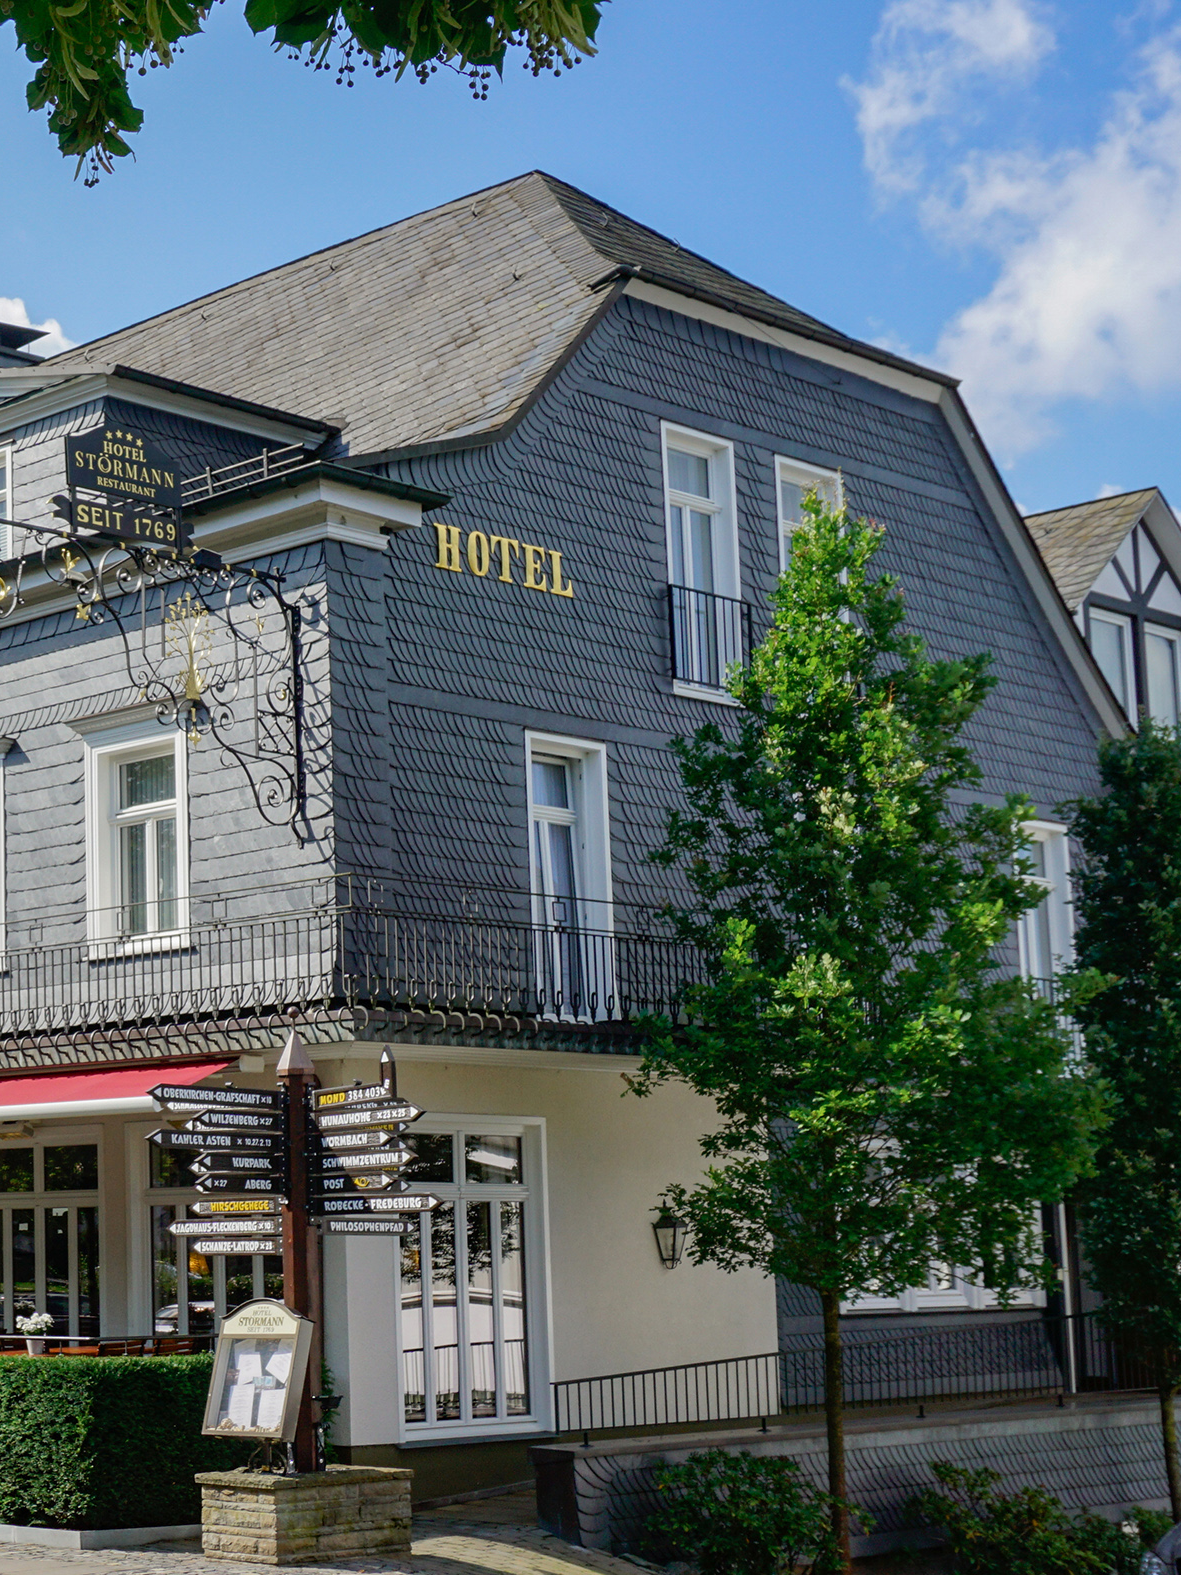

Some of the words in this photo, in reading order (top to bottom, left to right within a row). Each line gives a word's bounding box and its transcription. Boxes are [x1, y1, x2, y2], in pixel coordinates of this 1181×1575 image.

[103, 440, 147, 463] HOTEL
[75, 450, 174, 488] STÖRMANN
[97, 476, 156, 498] RESTAURANT
[77, 504, 123, 530] SEIT
[134, 517, 176, 541] 1769
[433, 522, 574, 598] HOTEL
[320, 1092, 345, 1105] MOND
[347, 1088, 363, 1101] 384
[365, 1086, 380, 1098] 403
[210, 1113, 259, 1126] WILZENBERG
[171, 1133, 204, 1145] KAHLER
[205, 1135, 231, 1146] ASTEN
[321, 1133, 368, 1147] WORMBACH
[232, 1157, 272, 1169] KURPARK
[322, 1152, 399, 1168] SCHWIMMZENTRUM
[244, 1180, 272, 1190] ABERG
[323, 1179, 345, 1189] POST
[210, 1200, 270, 1212] HIRSCHGEHEGE
[330, 1221, 404, 1232] PHILOSOPHENPFAD
